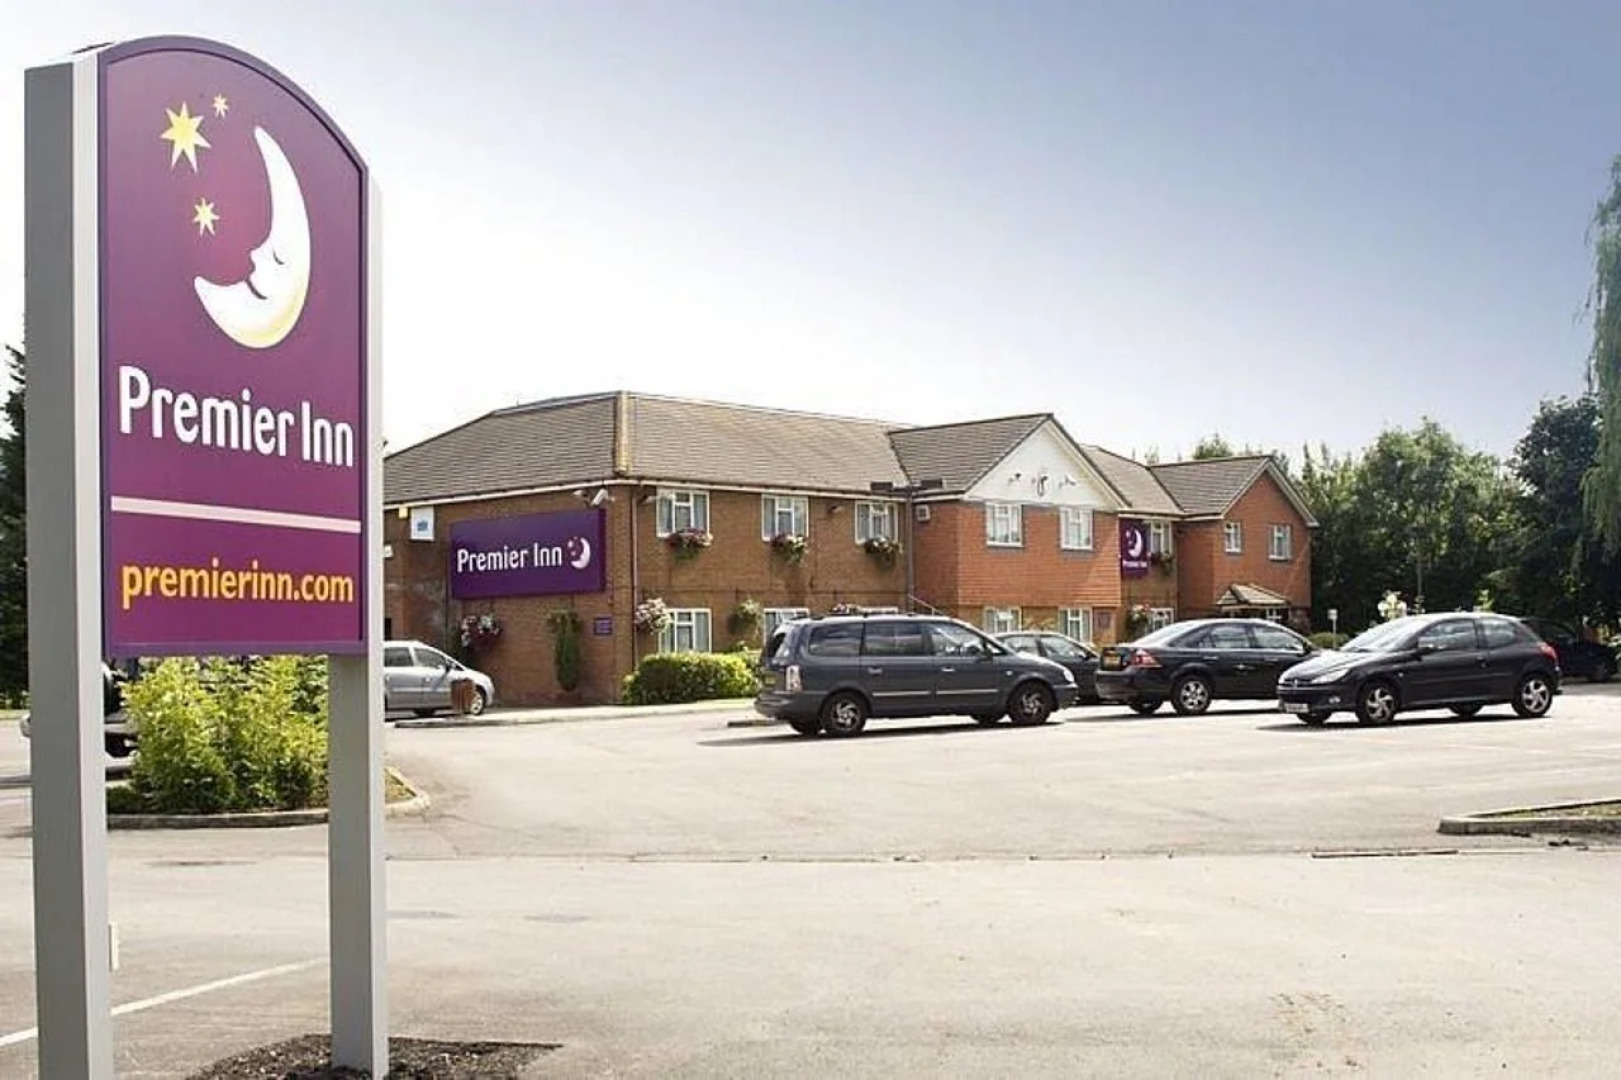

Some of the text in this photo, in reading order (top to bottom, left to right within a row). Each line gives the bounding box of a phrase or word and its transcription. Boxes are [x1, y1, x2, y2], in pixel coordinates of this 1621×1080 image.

[118, 365, 354, 468] Premier Inn
[122, 556, 353, 610] premierinn.com
[457, 543, 562, 573] Premier Inn
